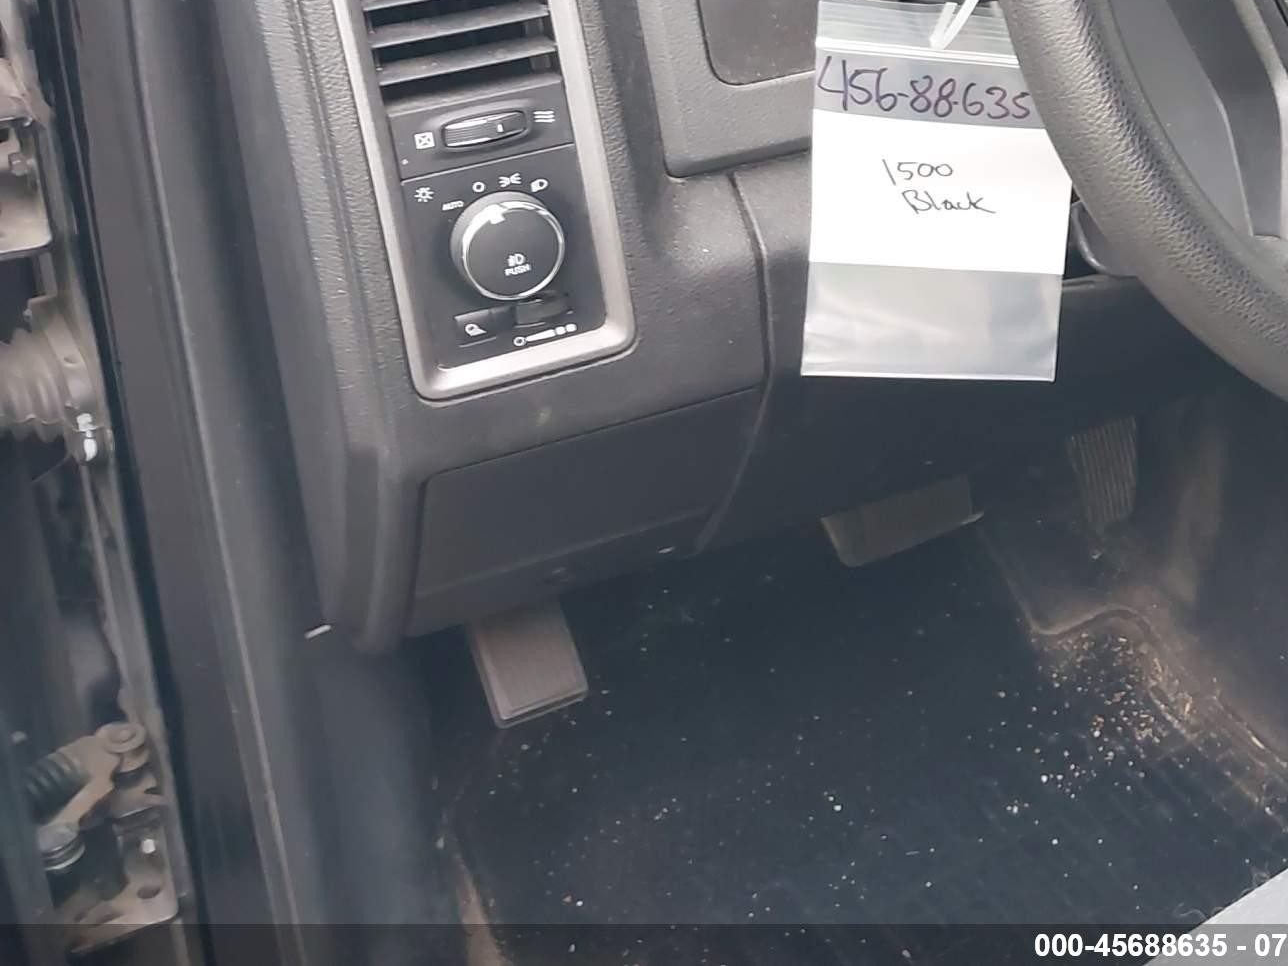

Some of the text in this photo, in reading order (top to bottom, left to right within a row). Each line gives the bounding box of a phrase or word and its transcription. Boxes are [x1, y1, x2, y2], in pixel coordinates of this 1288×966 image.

[882, 158, 954, 186] 1500
[902, 189, 997, 214] Black
[504, 263, 532, 277] PUSH
